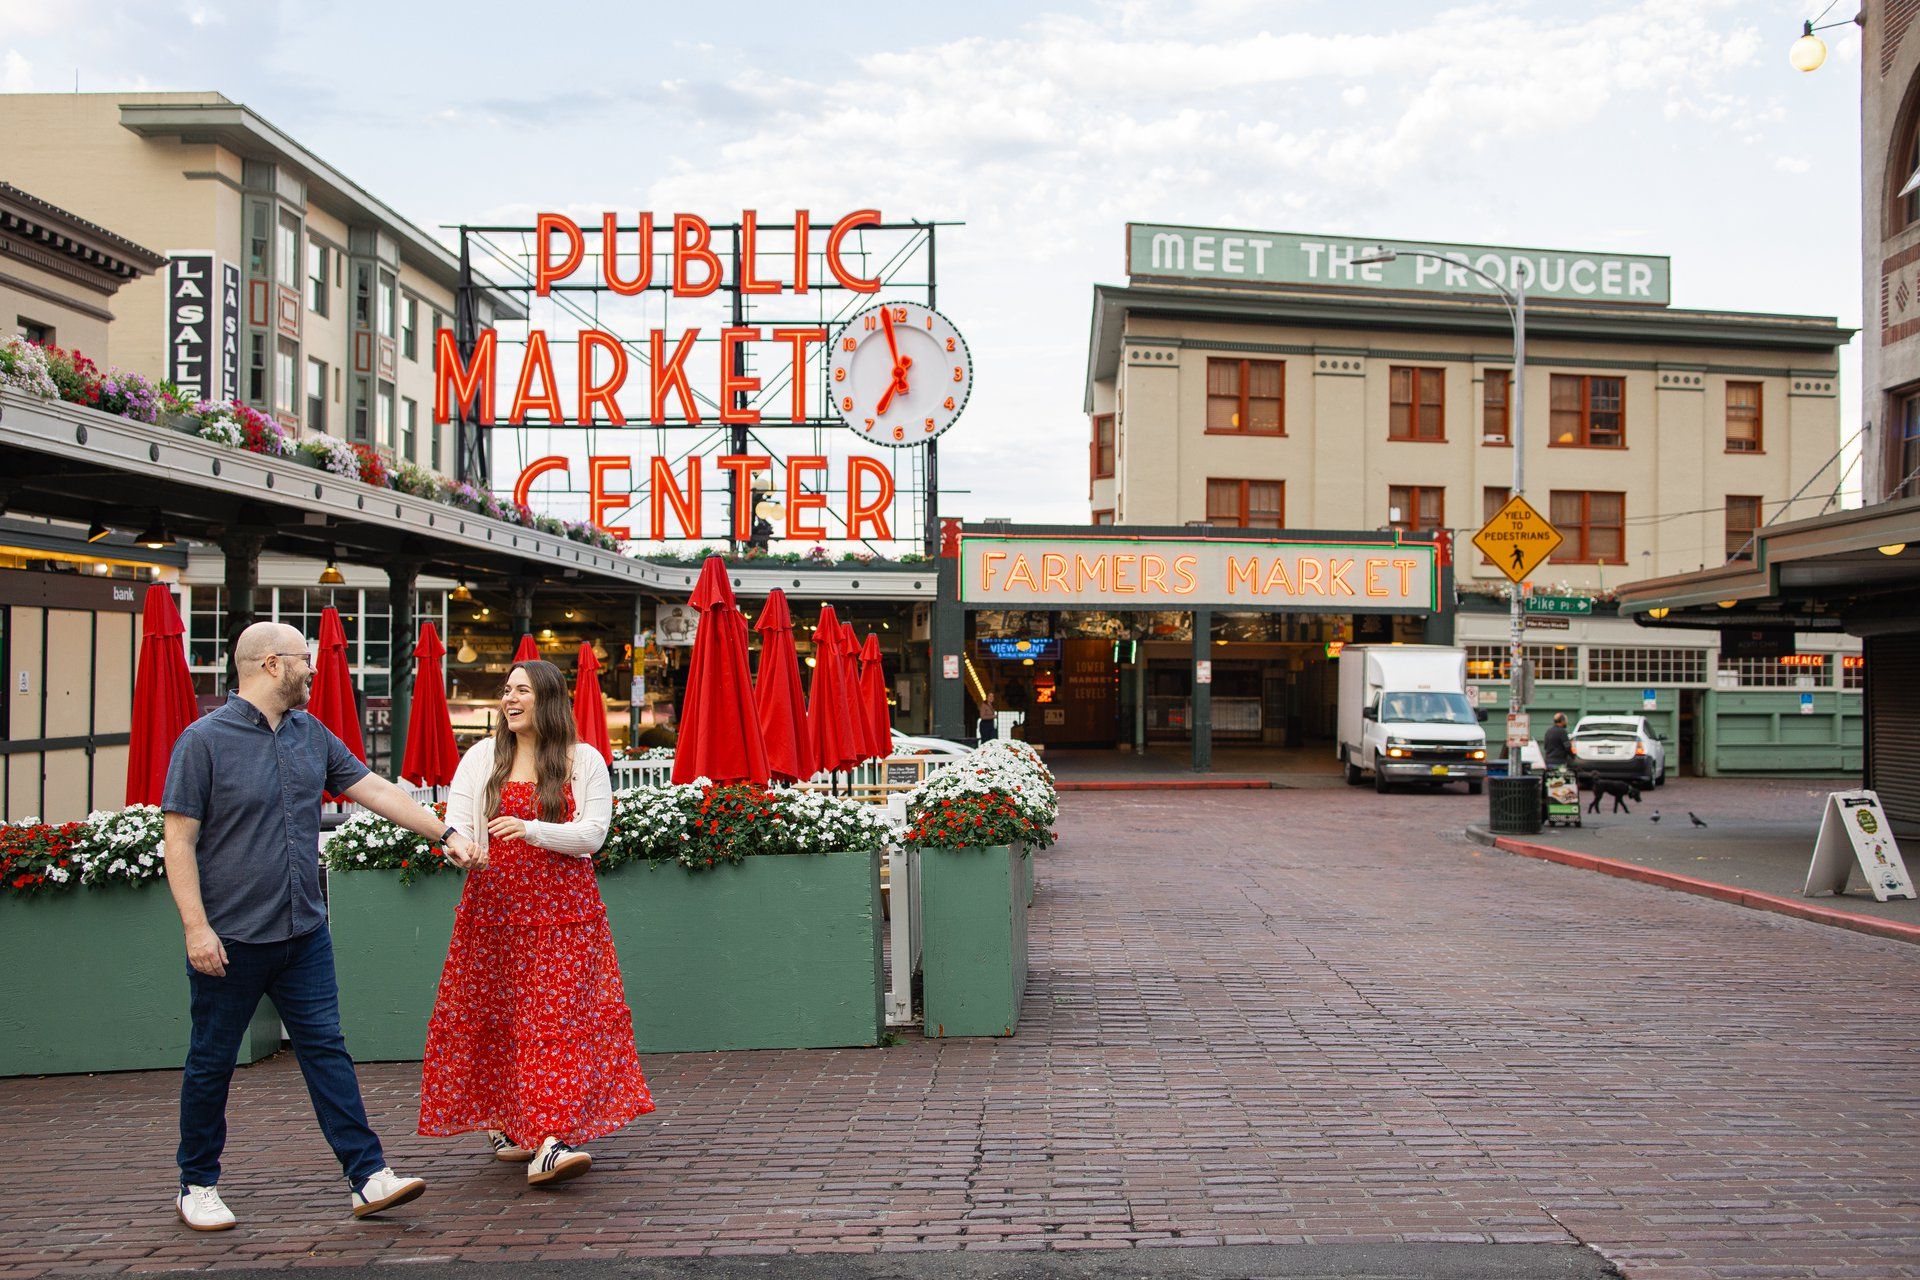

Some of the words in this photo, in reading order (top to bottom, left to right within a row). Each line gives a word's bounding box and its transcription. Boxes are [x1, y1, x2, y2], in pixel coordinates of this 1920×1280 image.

[537, 209, 881, 297] PUBLIC
[1151, 232, 1273, 274] MEET
[1300, 241, 1383, 282] THE
[1415, 249, 1653, 297] PRODUCER
[893, 308, 907, 323] 12
[926, 316, 932, 330] 1
[864, 316, 876, 331] 11
[843, 337, 857, 351] 10
[946, 337, 955, 352] 2
[435, 327, 827, 426] MARKET
[835, 367, 846, 381] 9
[953, 366, 963, 381] 3
[842, 396, 853, 411] 8
[943, 396, 955, 411] 4
[864, 418, 875, 432] 7
[893, 425, 904, 440] 6
[925, 418, 934, 432] 5
[513, 455, 896, 542] CENTER
[1504, 511, 1531, 520] YIELD
[1512, 521, 1524, 530] TO
[1484, 532, 1550, 541] PEDESTRIANS
[981, 551, 1198, 594] FARMERS
[1227, 555, 1418, 598] MARKET
[113, 586, 134, 602] bank
[1529, 597, 1555, 611] Pike
[990, 643, 1045, 653] VIEWINT
[1076, 661, 1105, 673] LOWER
[1075, 687, 1107, 699] LEVELS
